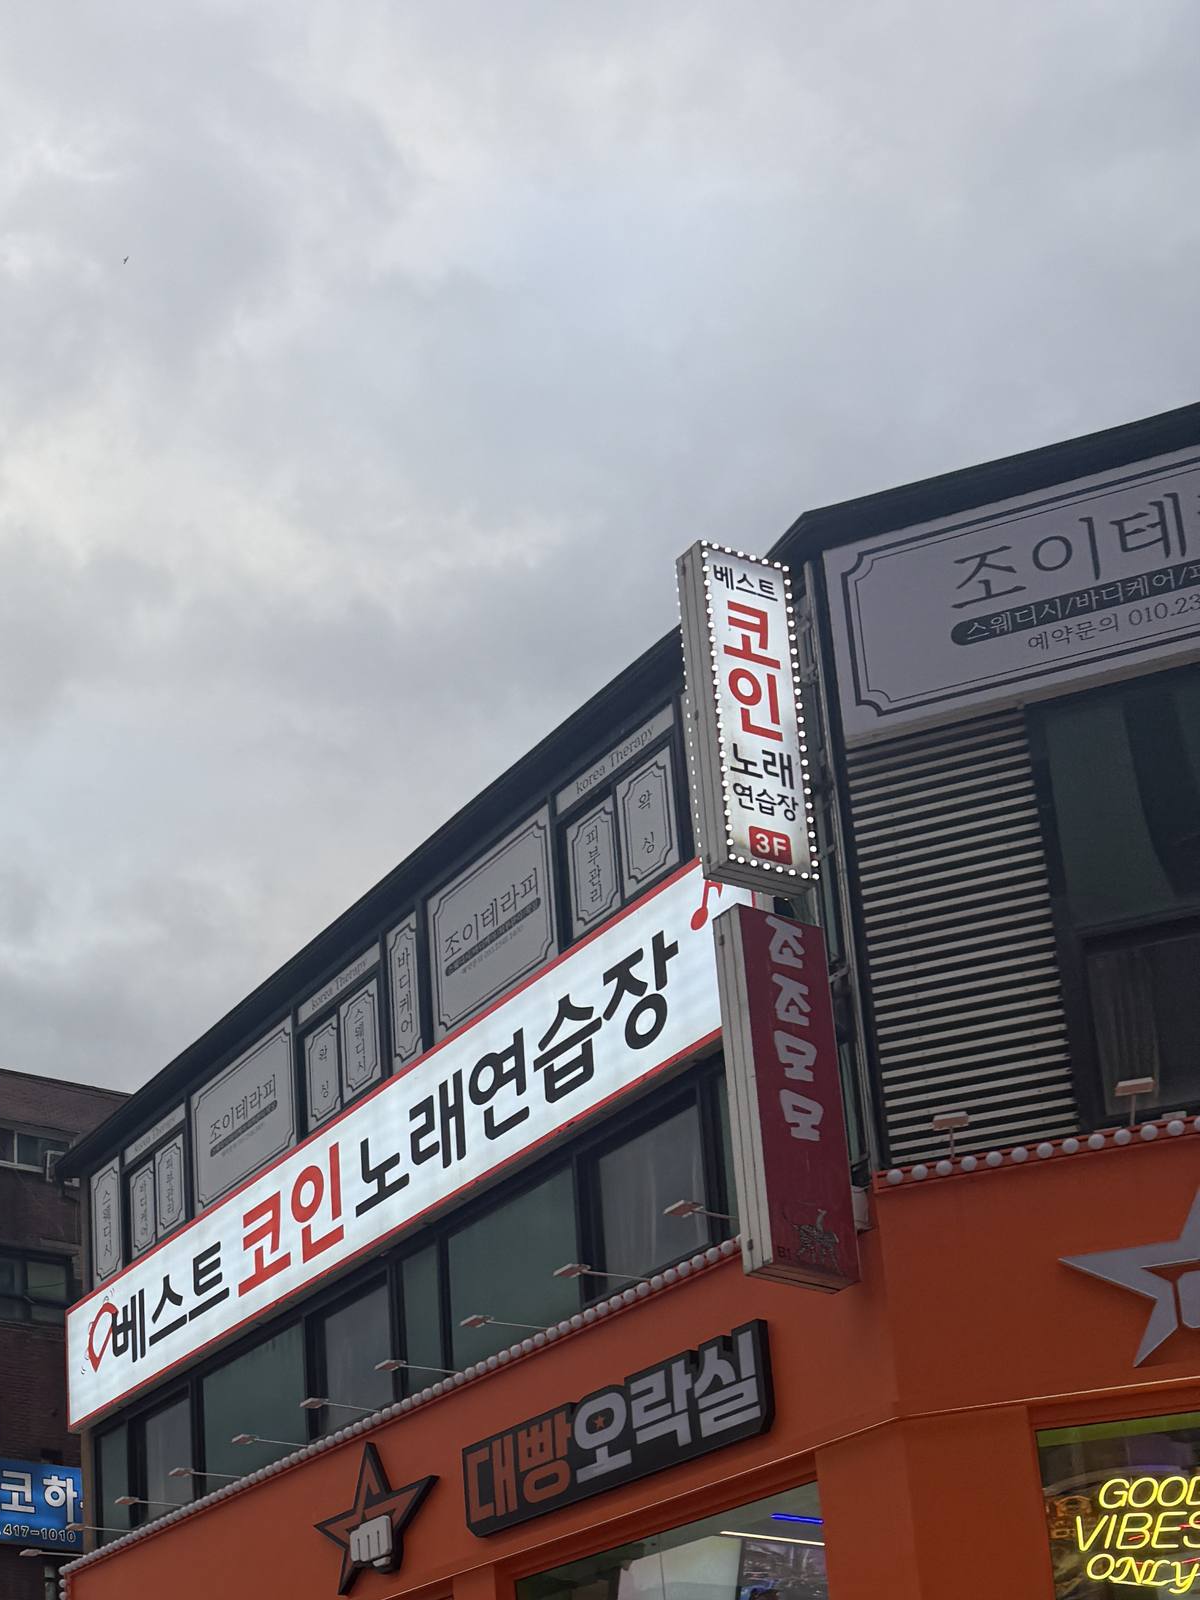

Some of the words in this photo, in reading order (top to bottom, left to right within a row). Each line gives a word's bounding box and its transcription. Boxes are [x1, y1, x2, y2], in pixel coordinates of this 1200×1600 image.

[713, 565, 778, 601] 베스트
[952, 491, 1200, 609] 조이테
[1028, 613, 1119, 650] 예약문의
[723, 600, 783, 742] 코인
[730, 743, 795, 790] 노래
[732, 782, 798, 822] 연습장
[585, 825, 603, 903] 피부관리
[755, 832, 786, 857] 3F
[444, 867, 539, 962] 조이테라피
[397, 947, 414, 1034] 바디케어
[209, 1074, 277, 1145] 조이테라피
[111, 1242, 229, 1363] 베스트
[238, 1143, 345, 1297] 코인
[356, 930, 678, 1218] 노래연습장
[1086, 1553, 1200, 1594] ONLY
